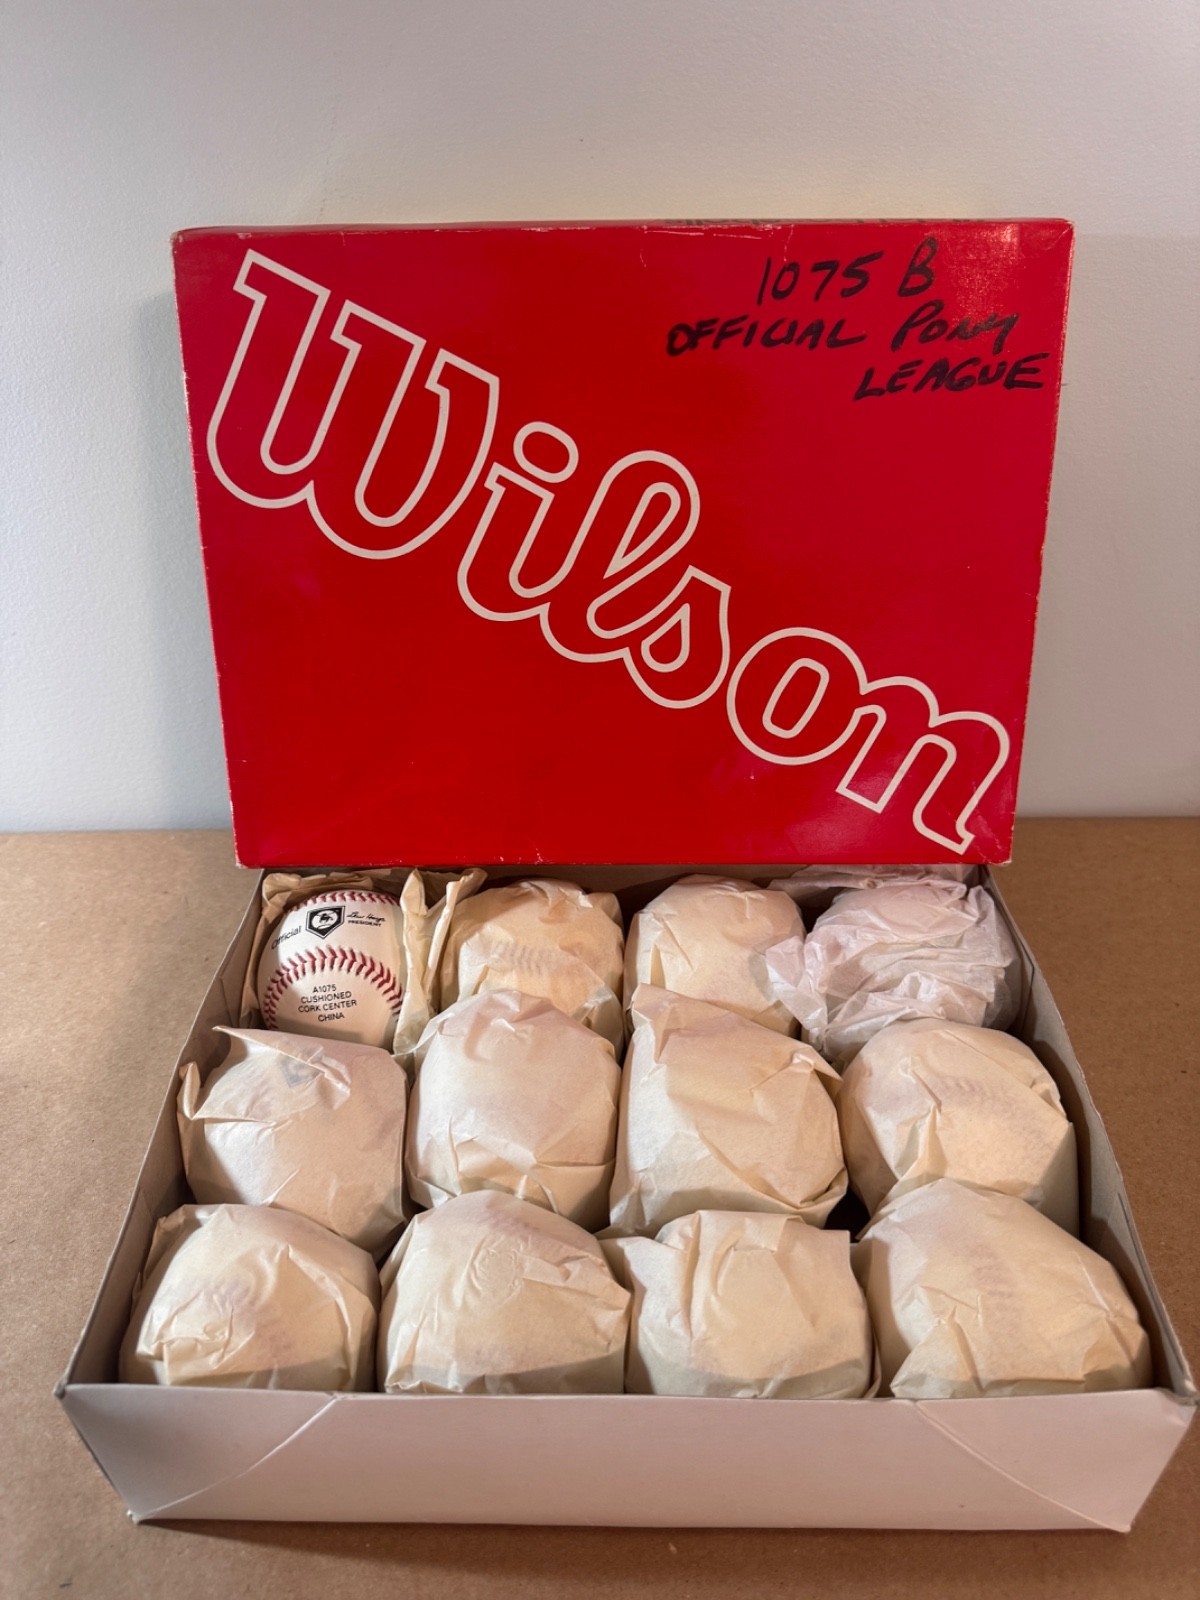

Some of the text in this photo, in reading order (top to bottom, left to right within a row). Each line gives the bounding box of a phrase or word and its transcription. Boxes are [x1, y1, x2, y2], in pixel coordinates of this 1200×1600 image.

[756, 236, 939, 306] 1075 B
[666, 313, 867, 357] OFFICIAL
[852, 351, 1051, 402] LEAGUE
[206, 248, 1011, 856] Wilson
[271, 925, 302, 950] Official
[300, 990, 352, 1004] CUSHIONED
[312, 984, 337, 993] A1075
[297, 999, 358, 1013] CORK CENTER
[317, 1012, 345, 1022] CHINA
